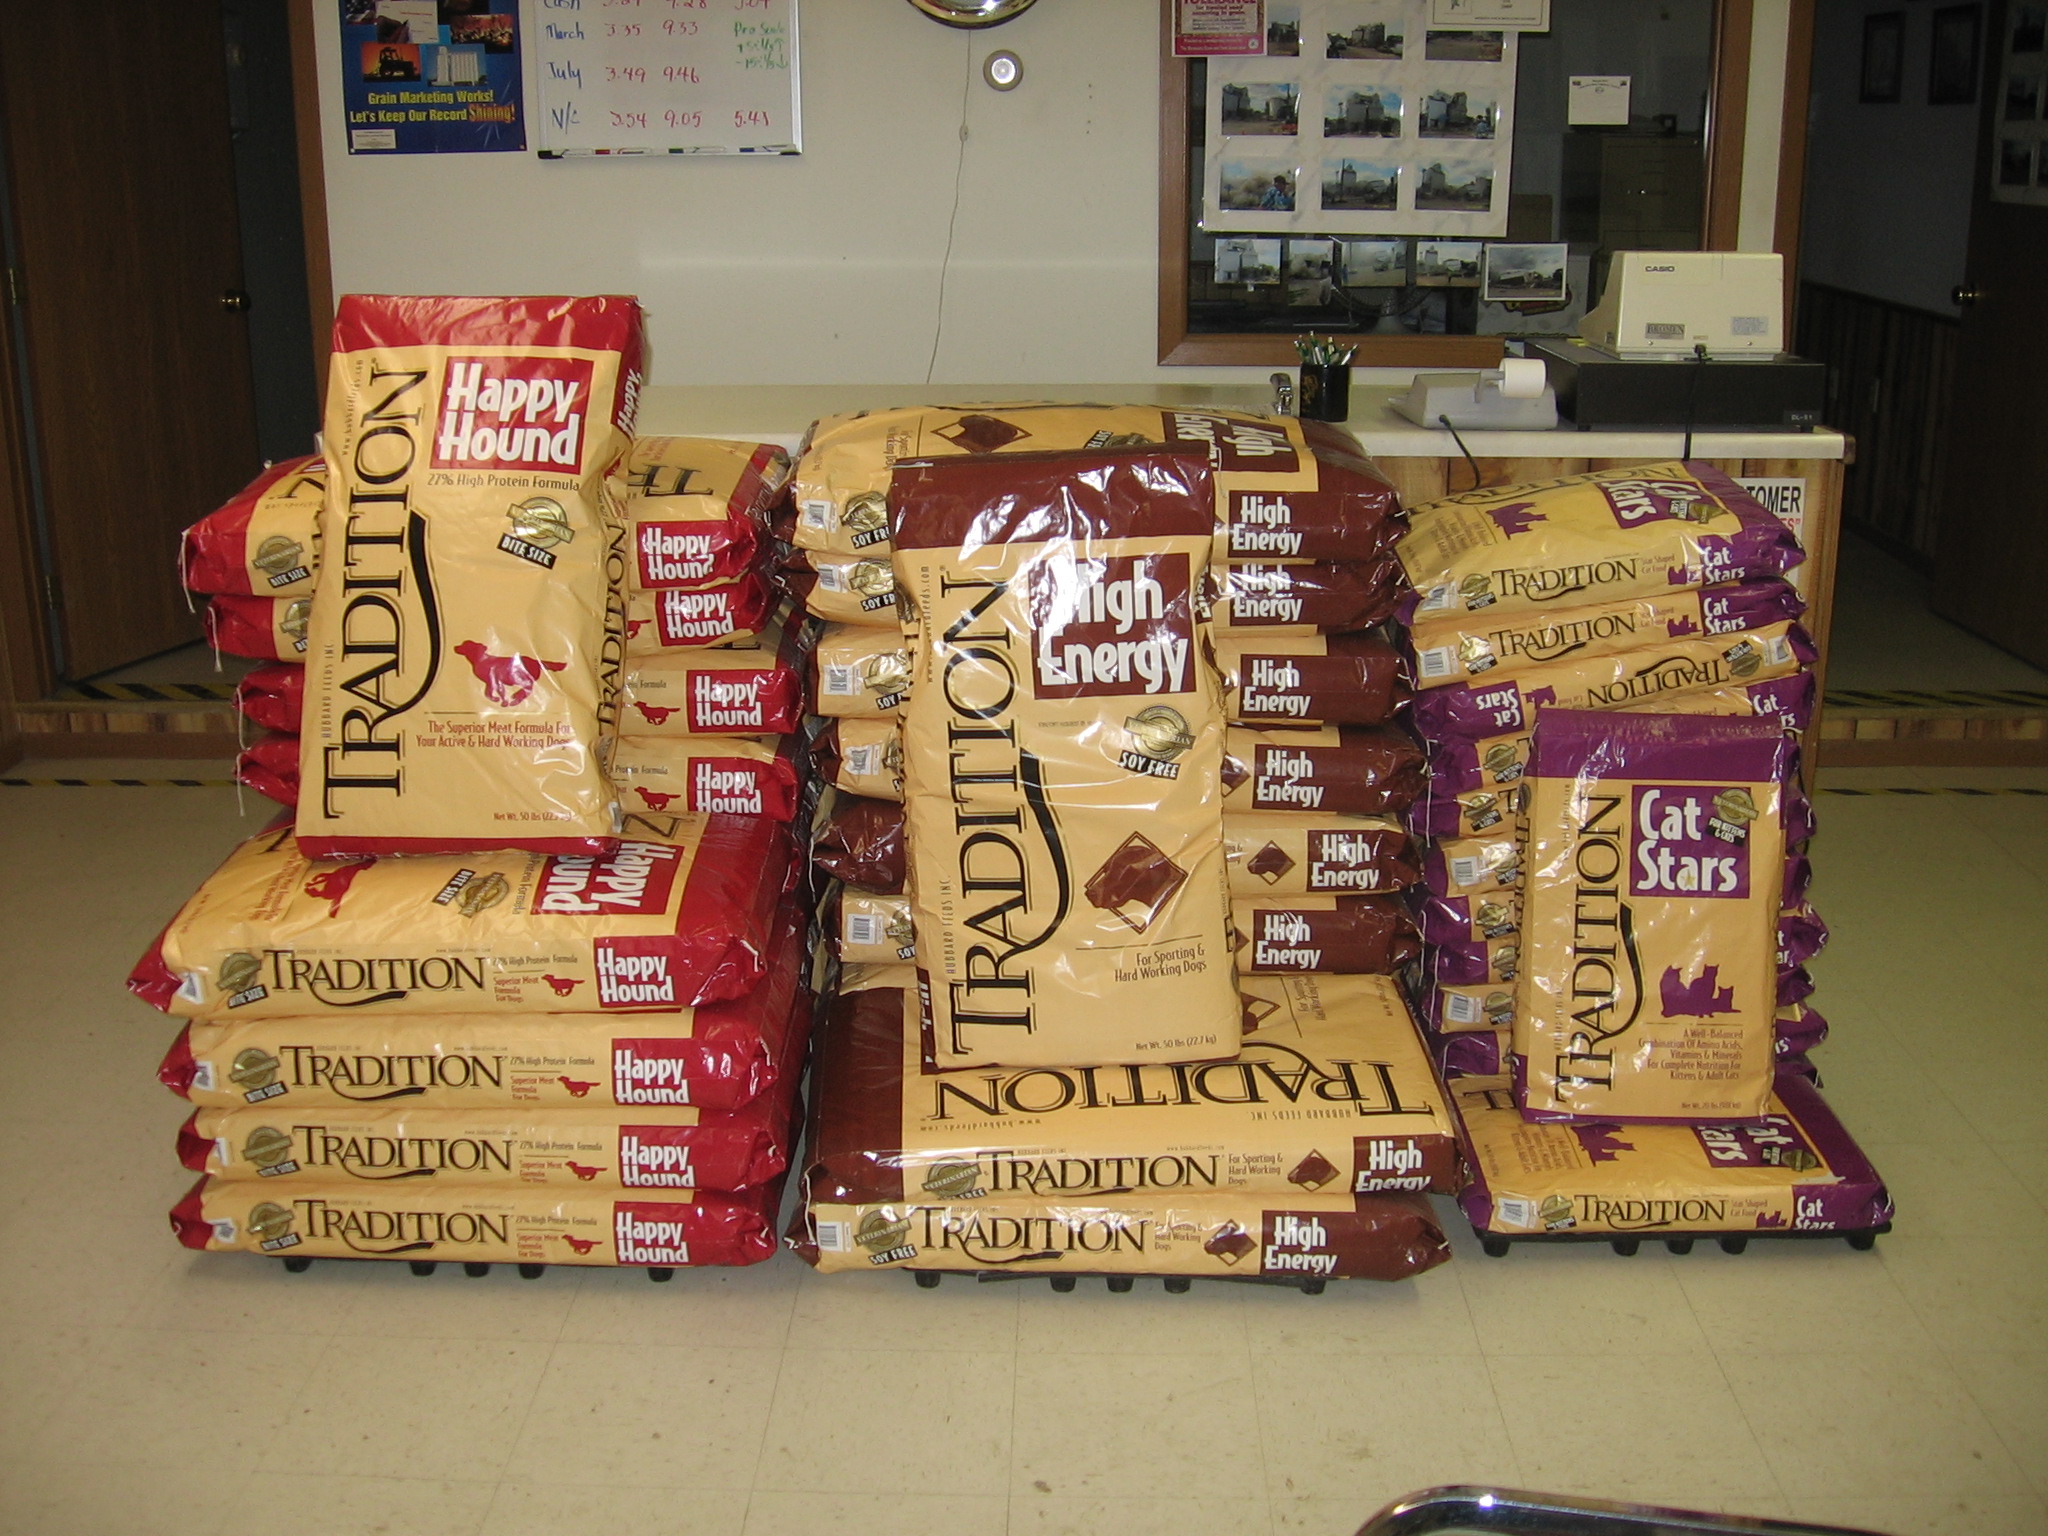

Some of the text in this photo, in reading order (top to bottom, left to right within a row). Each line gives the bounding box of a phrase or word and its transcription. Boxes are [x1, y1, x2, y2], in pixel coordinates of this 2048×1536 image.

[545, 21, 585, 41] March
[662, 19, 699, 36] 9.33
[547, 61, 700, 89] July 3.49 9.46
[368, 90, 494, 105] Grain Marketing Works!
[350, 104, 516, 124] Let's Keep Our Record Shining!
[664, 110, 702, 128] 9.05
[447, 362, 579, 423] Happy
[438, 411, 580, 466] Hound
[427, 472, 580, 491] 27% High Protein Formula
[1241, 495, 1290, 529] High
[1746, 485, 1802, 513] TOMER
[501, 535, 553, 567] BITE SIZE
[644, 527, 711, 560] Happy
[852, 533, 876, 549] SOY
[1232, 523, 1303, 555] Energy
[648, 554, 715, 581] Hound
[1704, 546, 1732, 567] Cat
[1242, 563, 1291, 596] High
[1492, 558, 1637, 602] TRADITION
[1705, 566, 1745, 585] Stars
[322, 364, 441, 819] TRADITION
[664, 590, 728, 619] Happy
[862, 596, 882, 611] SOY
[1233, 591, 1303, 621] Energy
[1704, 597, 1729, 618] Cat
[667, 611, 734, 639] Hound
[1489, 613, 1635, 661] TRADITION
[1705, 616, 1746, 635] Stars
[1037, 627, 1188, 693] Energy
[1252, 659, 1299, 692] High
[1588, 656, 1729, 708] TRADITION
[321, 664, 334, 738] HUBBARD FEEDS
[695, 675, 758, 708] Happy
[1243, 686, 1311, 717] Energy
[1475, 687, 1519, 710] Stars
[1753, 694, 1779, 716] Cat
[428, 720, 445, 733] The
[447, 720, 486, 735] Superior
[488, 721, 513, 733] Meat
[515, 721, 554, 733] Formula
[696, 702, 763, 727] Hound
[1495, 707, 1521, 726] Cat
[416, 735, 544, 749] Your Active & Hard Working
[696, 763, 756, 795] Happy
[1120, 753, 1179, 778] SOY FREE
[1266, 750, 1313, 783] High
[696, 789, 762, 814] Hound
[1257, 777, 1324, 808] Energy
[941, 572, 1072, 1055] TRADITION
[1639, 789, 1702, 840] Cat
[1321, 834, 1371, 867] High
[590, 842, 676, 907] Happy
[1311, 862, 1380, 889] Energy
[1636, 840, 1738, 893] Stars
[940, 900, 954, 926] FEEDS
[1264, 915, 1311, 946] High
[899, 947, 915, 959] SOY
[943, 931, 957, 974] HUBBARD
[1136, 945, 1205, 966] For Sporting &
[1255, 940, 1321, 969] Energy
[1555, 795, 1646, 1102] TRADITION
[263, 950, 486, 1007] TRADITION
[597, 948, 668, 982] Happy
[1115, 960, 1207, 983] Hard Working Dogs
[600, 973, 674, 1003] Hound
[1164, 1038, 1174, 1049] 50
[279, 1046, 503, 1101] TRADITION
[615, 1049, 684, 1081] Happy
[615, 1079, 690, 1104] Hound
[927, 1041, 1434, 1121] TRADITION
[292, 1126, 513, 1180] TRADITION
[621, 1136, 690, 1168] Happy
[1228, 1153, 1276, 1165] For Sporting
[1369, 1139, 1423, 1174] High
[622, 1165, 695, 1188] Hound
[976, 1151, 1219, 1197] TRADITION
[1228, 1165, 1281, 1175] Hard Working
[1228, 1177, 1247, 1185] Dogs
[1355, 1171, 1431, 1193] Energy
[1574, 1195, 1726, 1229] TRADITION
[1797, 1196, 1823, 1219] Cat
[292, 1200, 509, 1253] TRADITION
[615, 1211, 683, 1246] Happy
[915, 1206, 1148, 1263] TRADITION
[1273, 1215, 1327, 1252] High
[1795, 1217, 1835, 1230] Stars
[616, 1241, 689, 1263] Hound
[870, 1245, 916, 1265] SOY FREE
[1265, 1245, 1337, 1274] Energy
